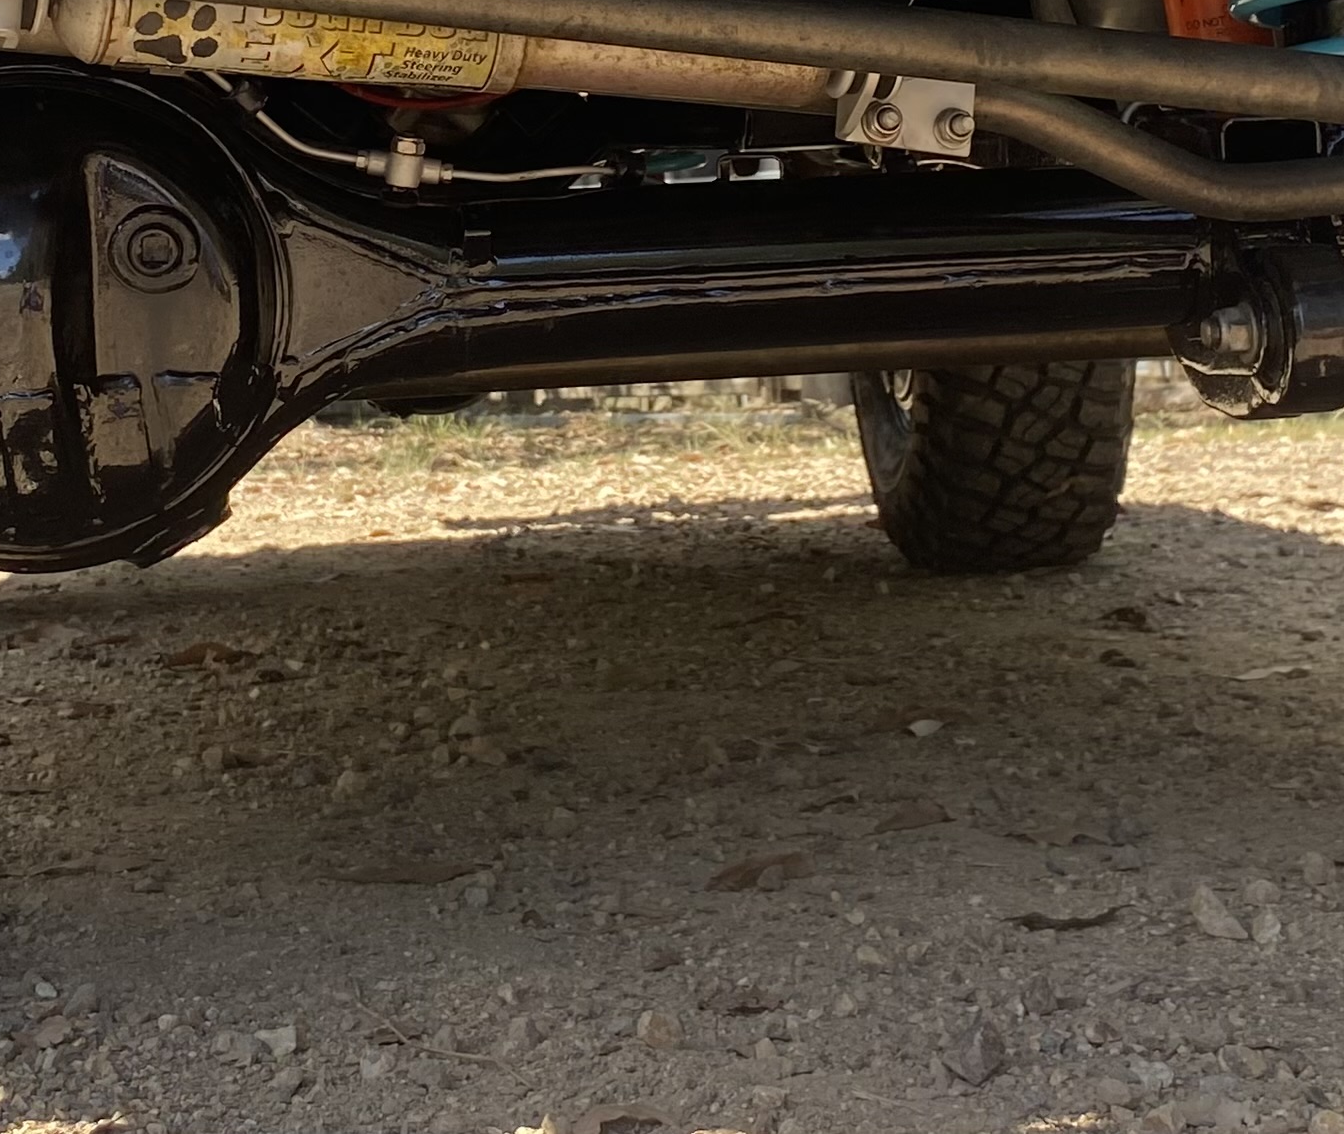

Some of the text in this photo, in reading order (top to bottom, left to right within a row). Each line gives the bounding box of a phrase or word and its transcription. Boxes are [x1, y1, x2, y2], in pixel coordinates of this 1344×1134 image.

[403, 46, 488, 65] Heavy Duty
[383, 69, 454, 82] Stabilizer
[400, 59, 463, 76] Steering
